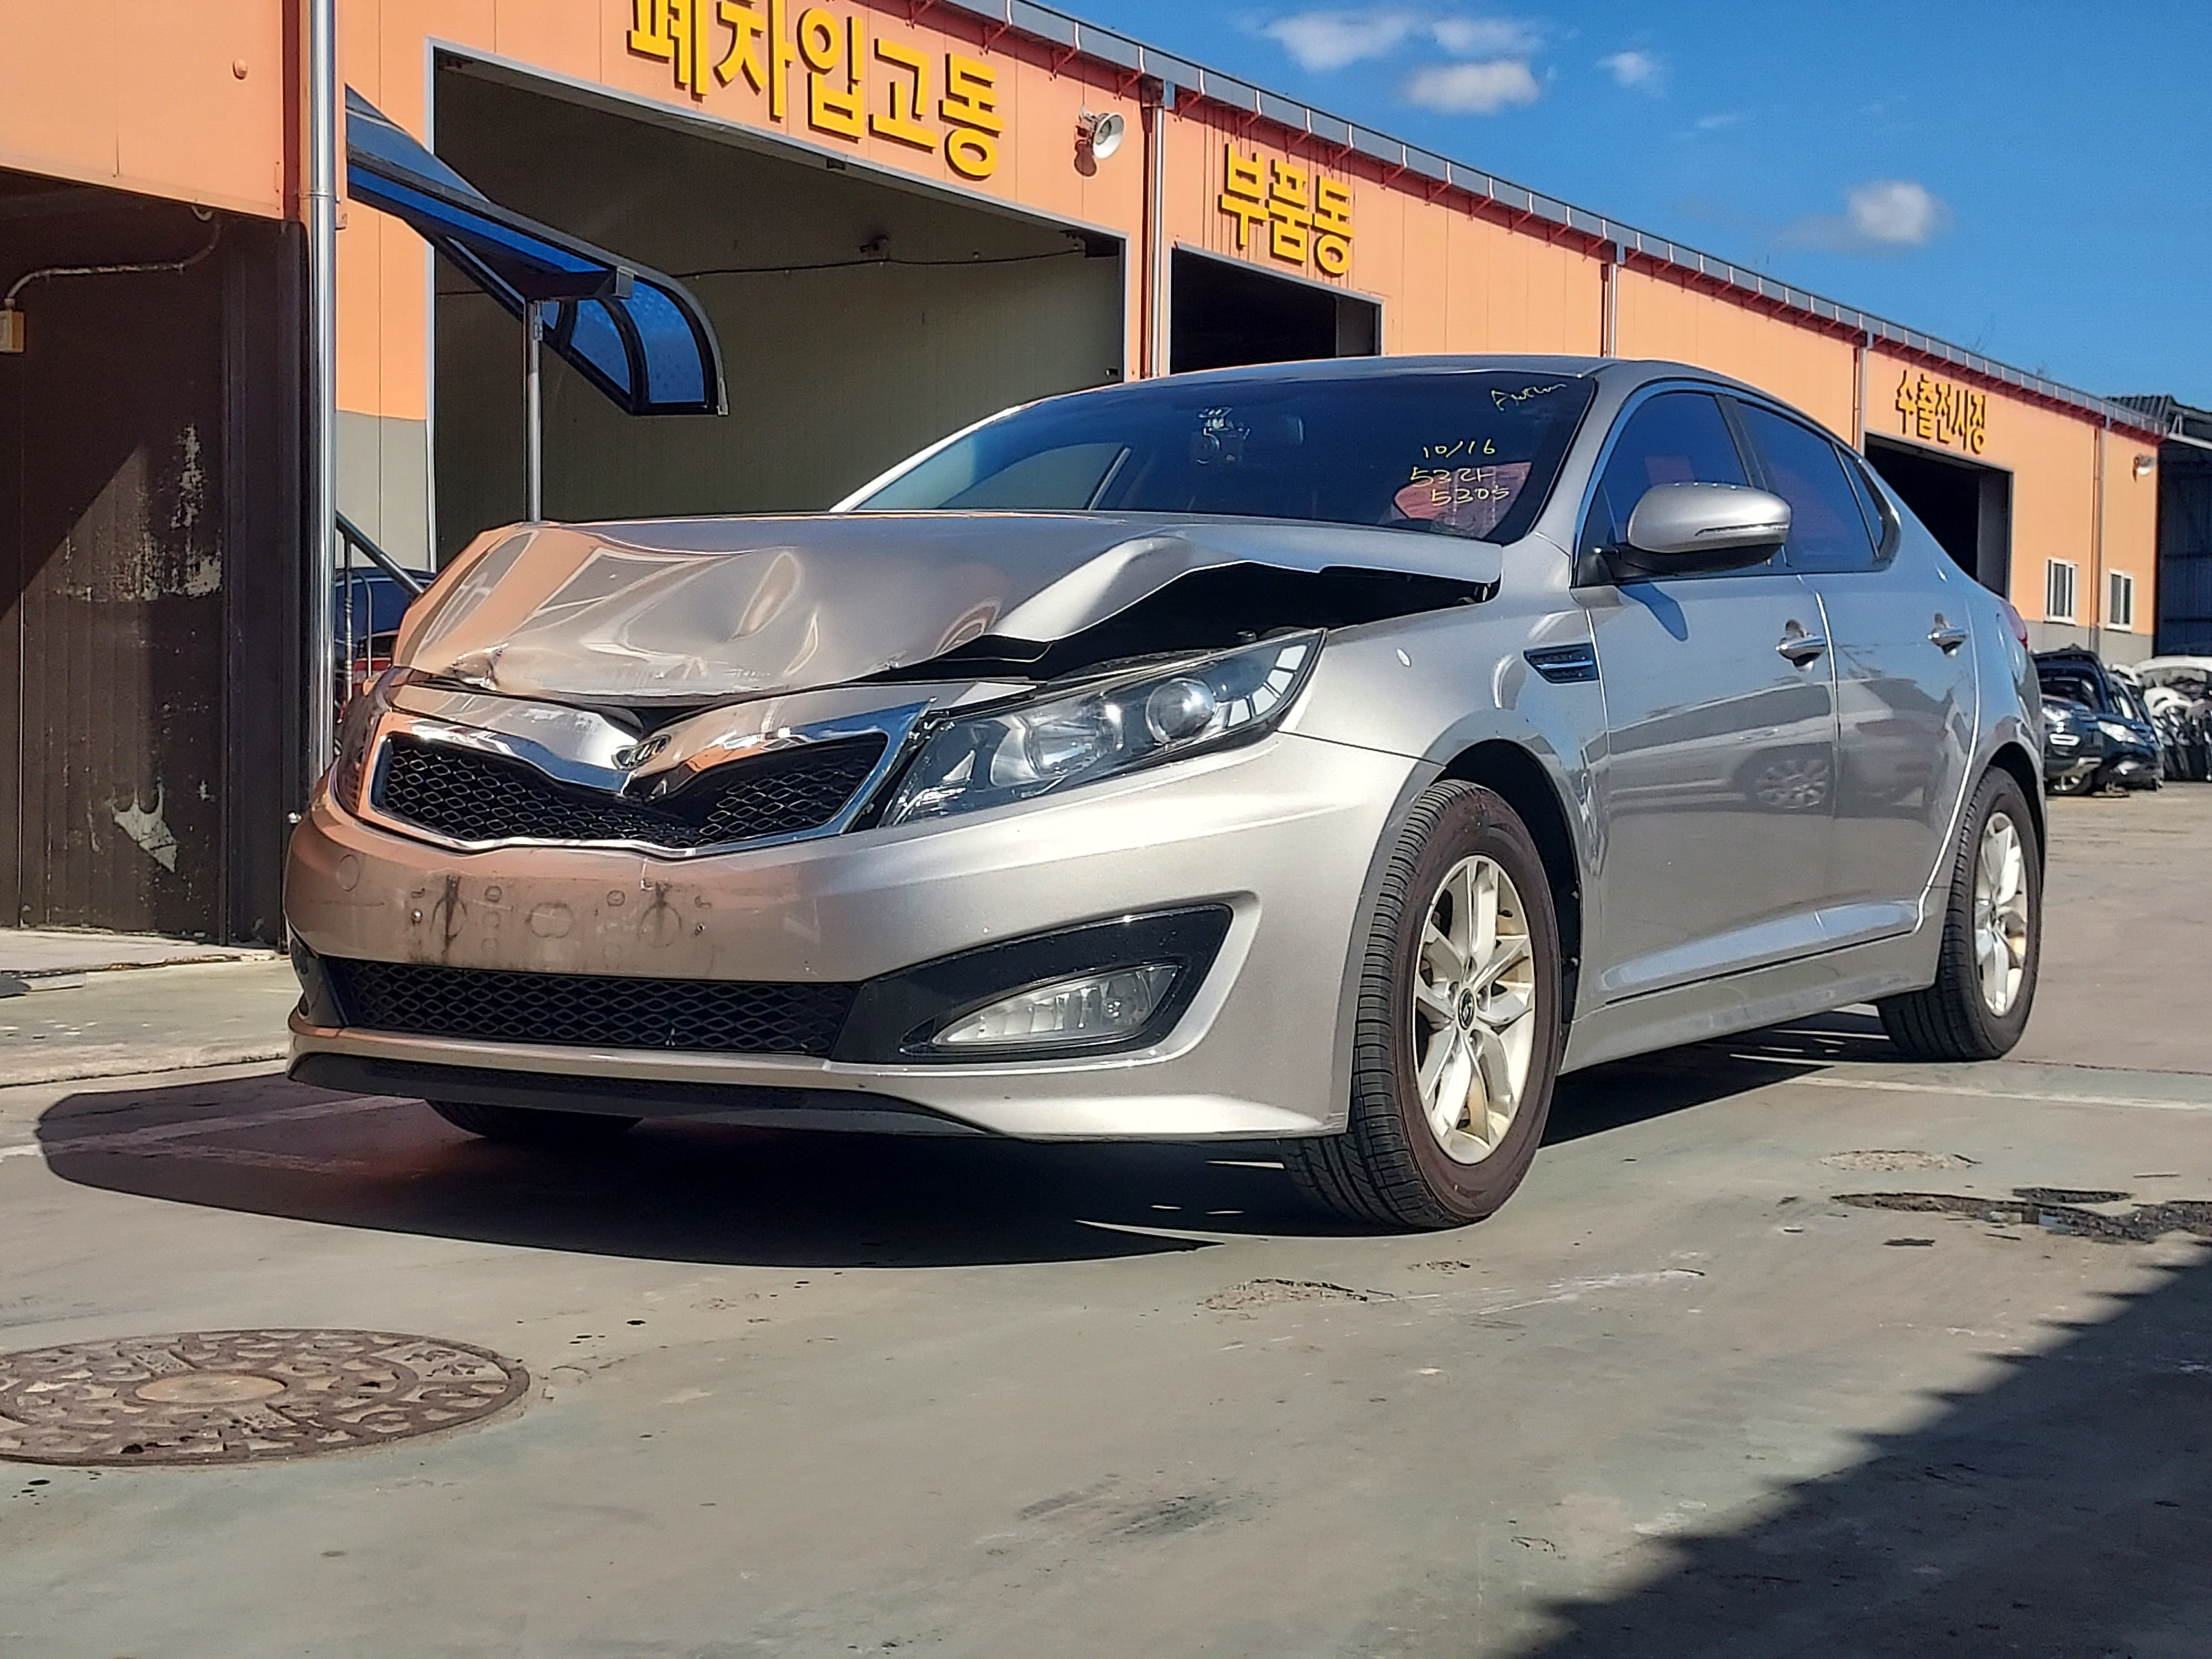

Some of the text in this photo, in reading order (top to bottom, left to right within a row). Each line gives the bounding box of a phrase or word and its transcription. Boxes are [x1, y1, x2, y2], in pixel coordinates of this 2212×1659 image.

[628, 0, 1003, 179] 폐차입고동
[1220, 144, 1354, 275] 부품동
[1423, 439, 1496, 458] 10/16
[1896, 370, 1987, 454] 수출전시장
